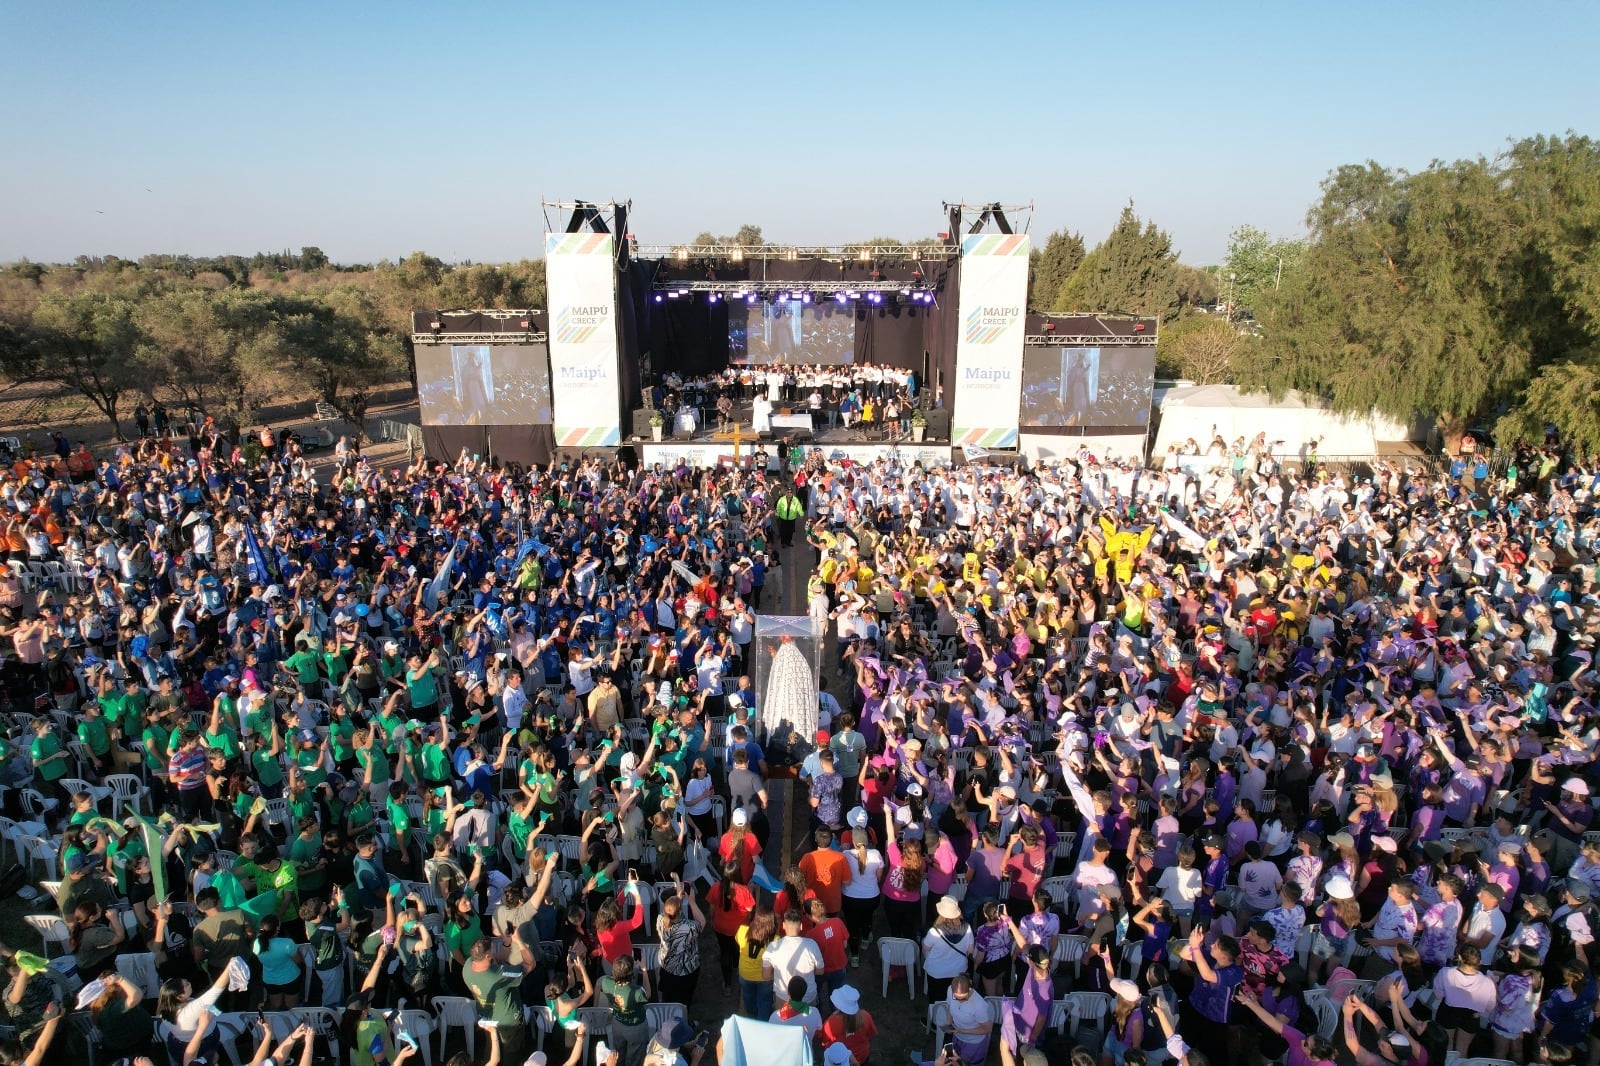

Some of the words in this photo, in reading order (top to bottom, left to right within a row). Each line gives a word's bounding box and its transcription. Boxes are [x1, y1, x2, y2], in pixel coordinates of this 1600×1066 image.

[571, 305, 608, 316] MAIPÚ
[983, 306, 1019, 317] MAIPÚ
[571, 317, 597, 325] CRECE
